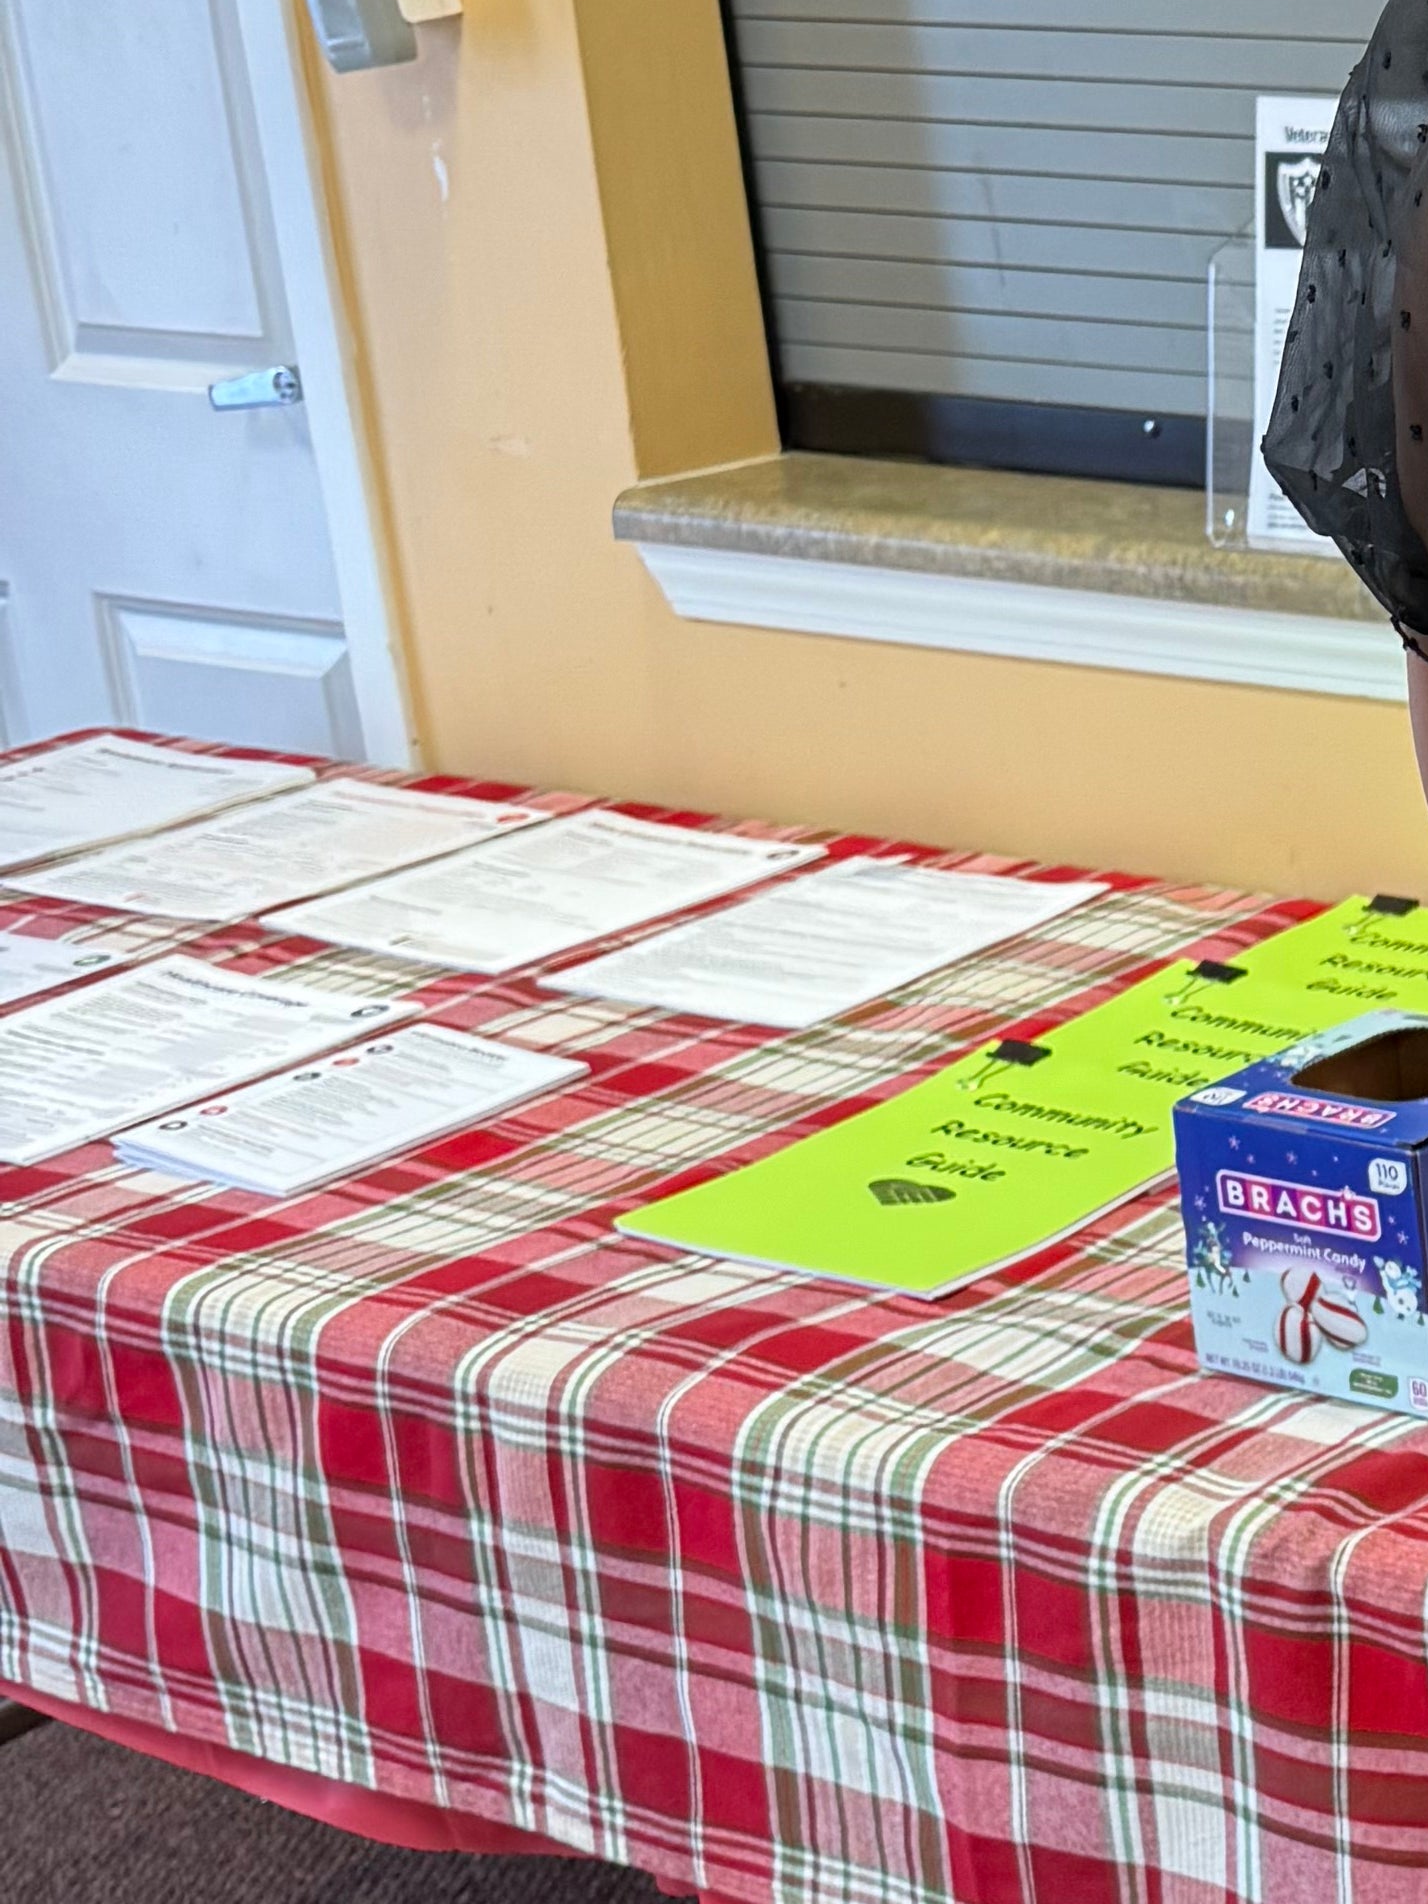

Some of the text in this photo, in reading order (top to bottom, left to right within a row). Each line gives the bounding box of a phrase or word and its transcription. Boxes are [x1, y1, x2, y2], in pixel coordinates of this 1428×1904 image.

[1284, 126, 1330, 143] Vetera
[1306, 976, 1399, 1002] Guide
[1116, 1060, 1210, 1088] Guide
[974, 1092, 1160, 1140] Community
[1254, 1094, 1385, 1127] BRACHS
[930, 1119, 1090, 1160] Resource
[905, 1151, 1007, 1182] Guide
[1375, 1162, 1399, 1181] 110
[1226, 1179, 1373, 1232] BRACHS
[1242, 1231, 1366, 1272] Peppermint Candy
